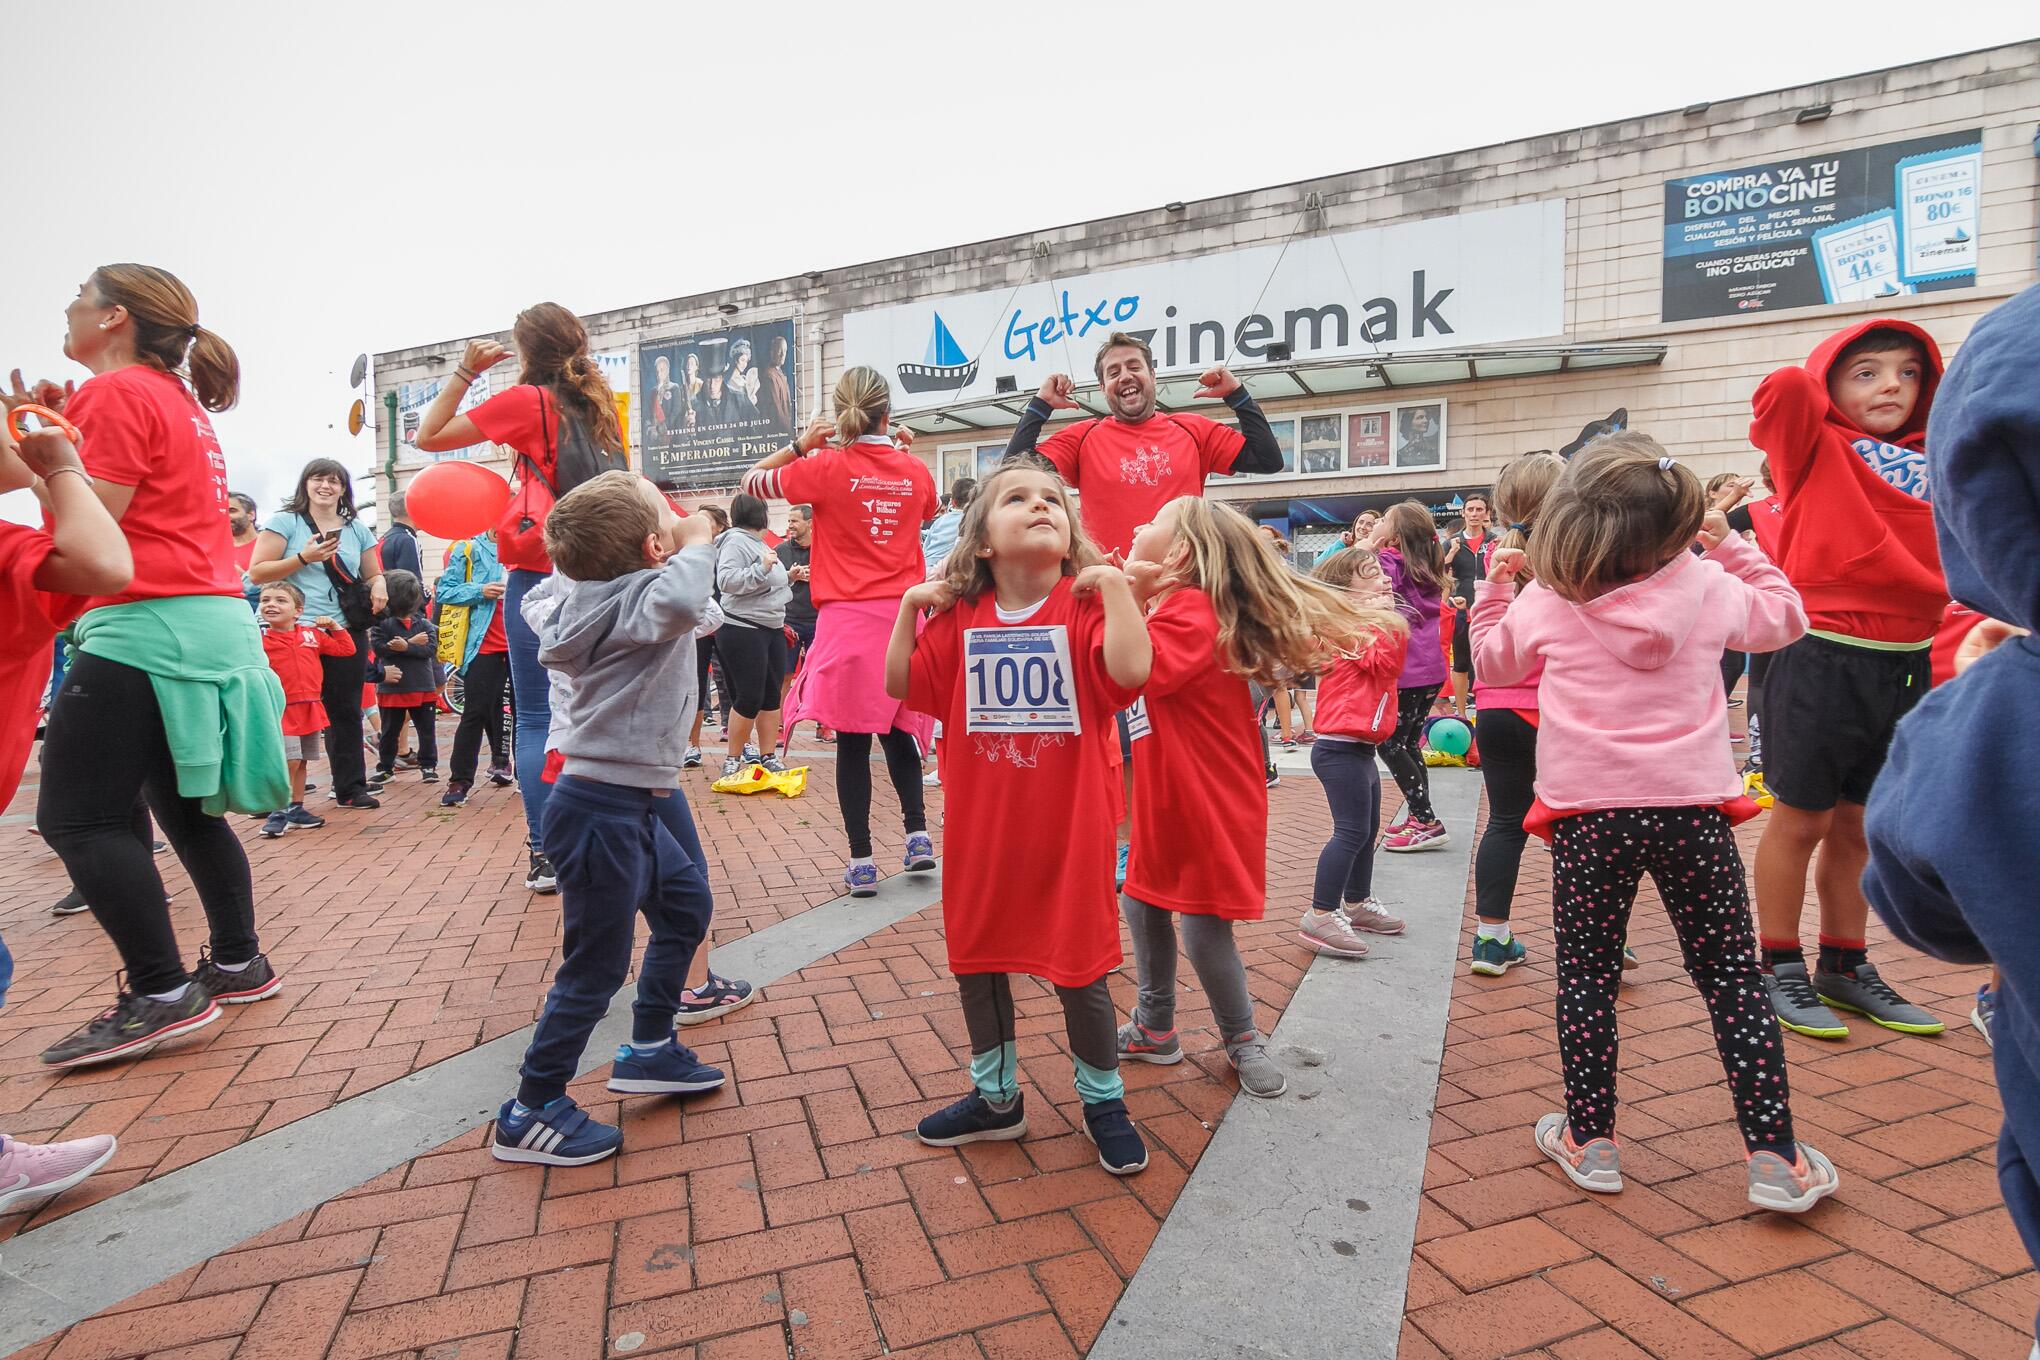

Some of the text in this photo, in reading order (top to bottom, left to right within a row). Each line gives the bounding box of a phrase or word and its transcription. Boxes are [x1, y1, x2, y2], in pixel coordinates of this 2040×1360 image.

[1686, 160, 1839, 198] COMPRA YA TU
[1916, 171, 1968, 185] CINEMA
[1684, 176, 1837, 219] BONOCINE
[1914, 186, 1973, 204] BONO 16
[1684, 202, 1836, 233] DISFRUTA DEL MEJOR CINE
[1927, 201, 1962, 221] 80€
[1684, 213, 1836, 242] CUALQUIER DÍA DE LA SEMANA.
[1713, 228, 1803, 248] SESIÓN Y PELÍCULA
[1696, 247, 1808, 269] CUANDO QUIERAS PORQUE
[1838, 249, 1875, 266] BONO
[1919, 245, 1968, 258] zinemak
[1733, 257, 1796, 274] CADUCA!
[1849, 259, 1886, 281] 44€
[1004, 290, 1140, 362] Getxo
[708, 423, 728, 432] CINES
[739, 420, 749, 428] DE
[750, 418, 771, 427] JULIO
[660, 446, 731, 465] EMPERADOR
[850, 478, 860, 492] 7
[876, 499, 902, 508] Seguros
[876, 506, 897, 514] Bilbao
